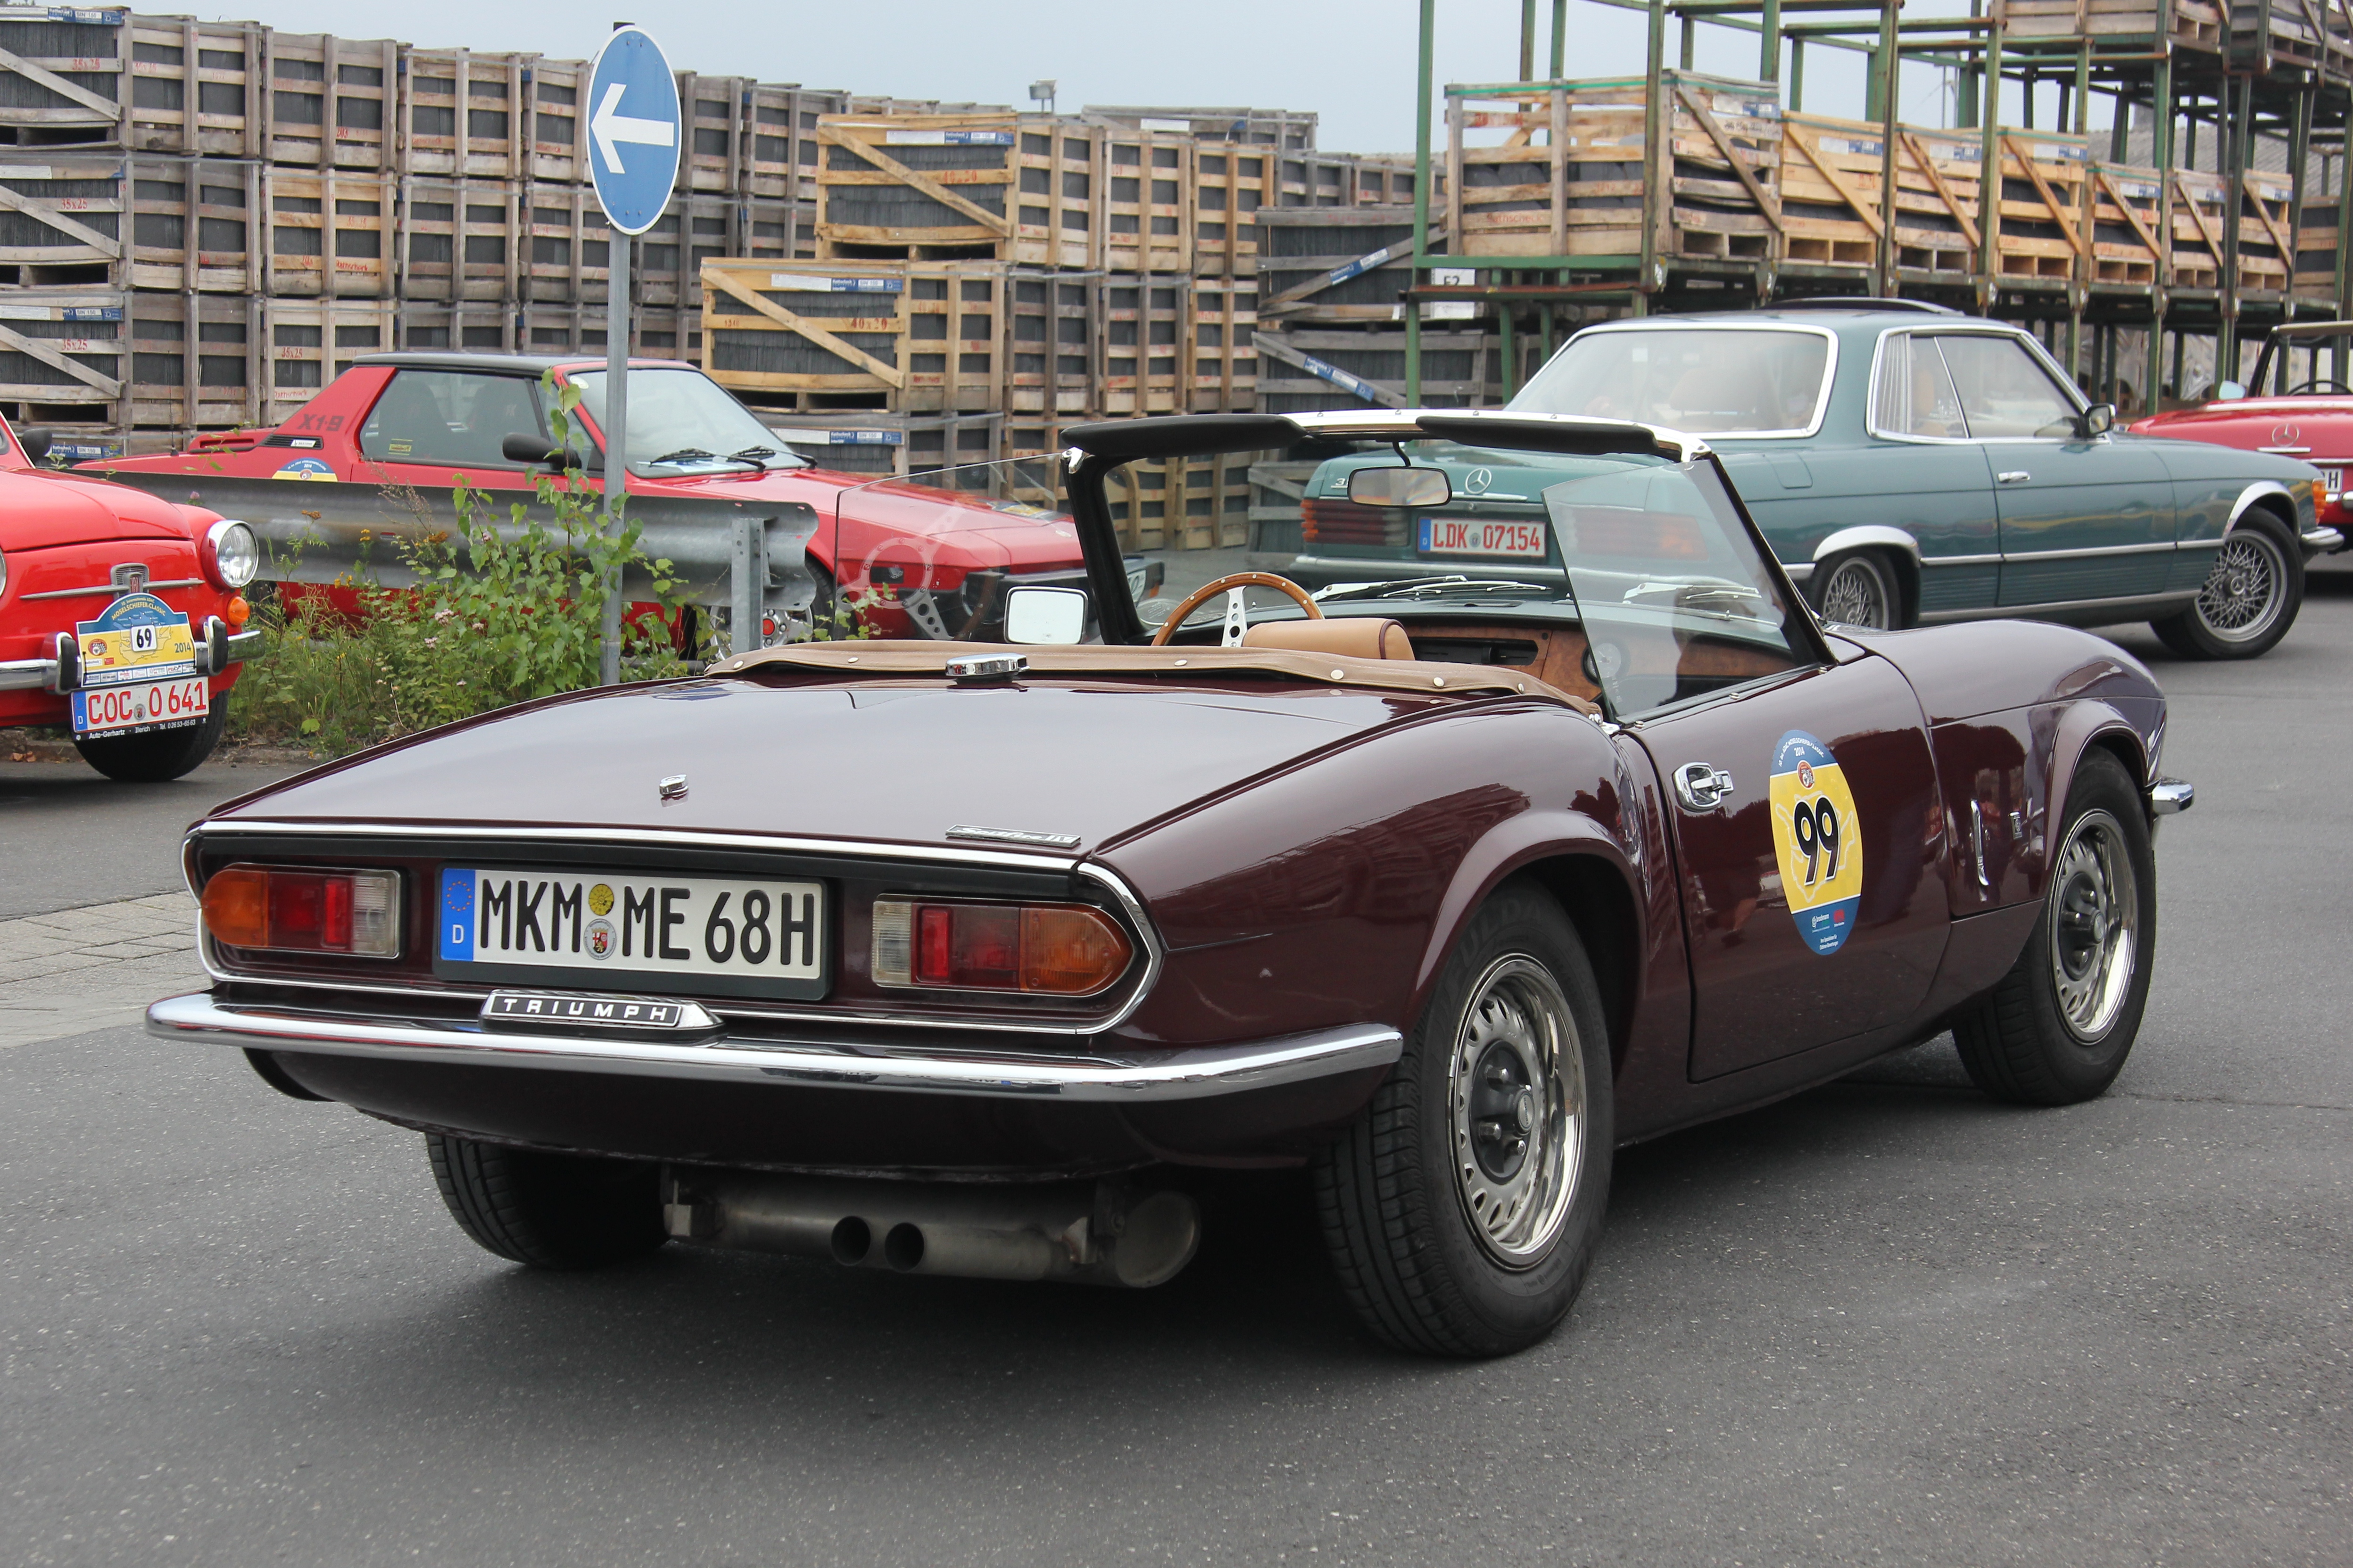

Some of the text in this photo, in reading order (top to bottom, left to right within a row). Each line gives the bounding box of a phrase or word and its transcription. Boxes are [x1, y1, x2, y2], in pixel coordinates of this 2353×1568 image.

[61, 198, 88, 209] 35x25
[851, 317, 887, 330] 40x20
[62, 338, 88, 350] 35x25
[282, 347, 303, 359] 35x25
[1434, 523, 1540, 551] LDK 07154
[111, 602, 166, 620] MOSELSCHIEFER-CLASSIC
[137, 628, 152, 648] 69
[174, 642, 191, 653] 2014
[89, 691, 133, 724] COC
[78, 716, 83, 724] D
[89, 728, 125, 739] Auto-Gerhartz
[1794, 746, 1805, 757] 2014
[1793, 794, 1841, 886] 99
[480, 879, 815, 966] MKM ME 68H
[452, 924, 464, 944] D
[504, 997, 669, 1022] TRIUMPH
